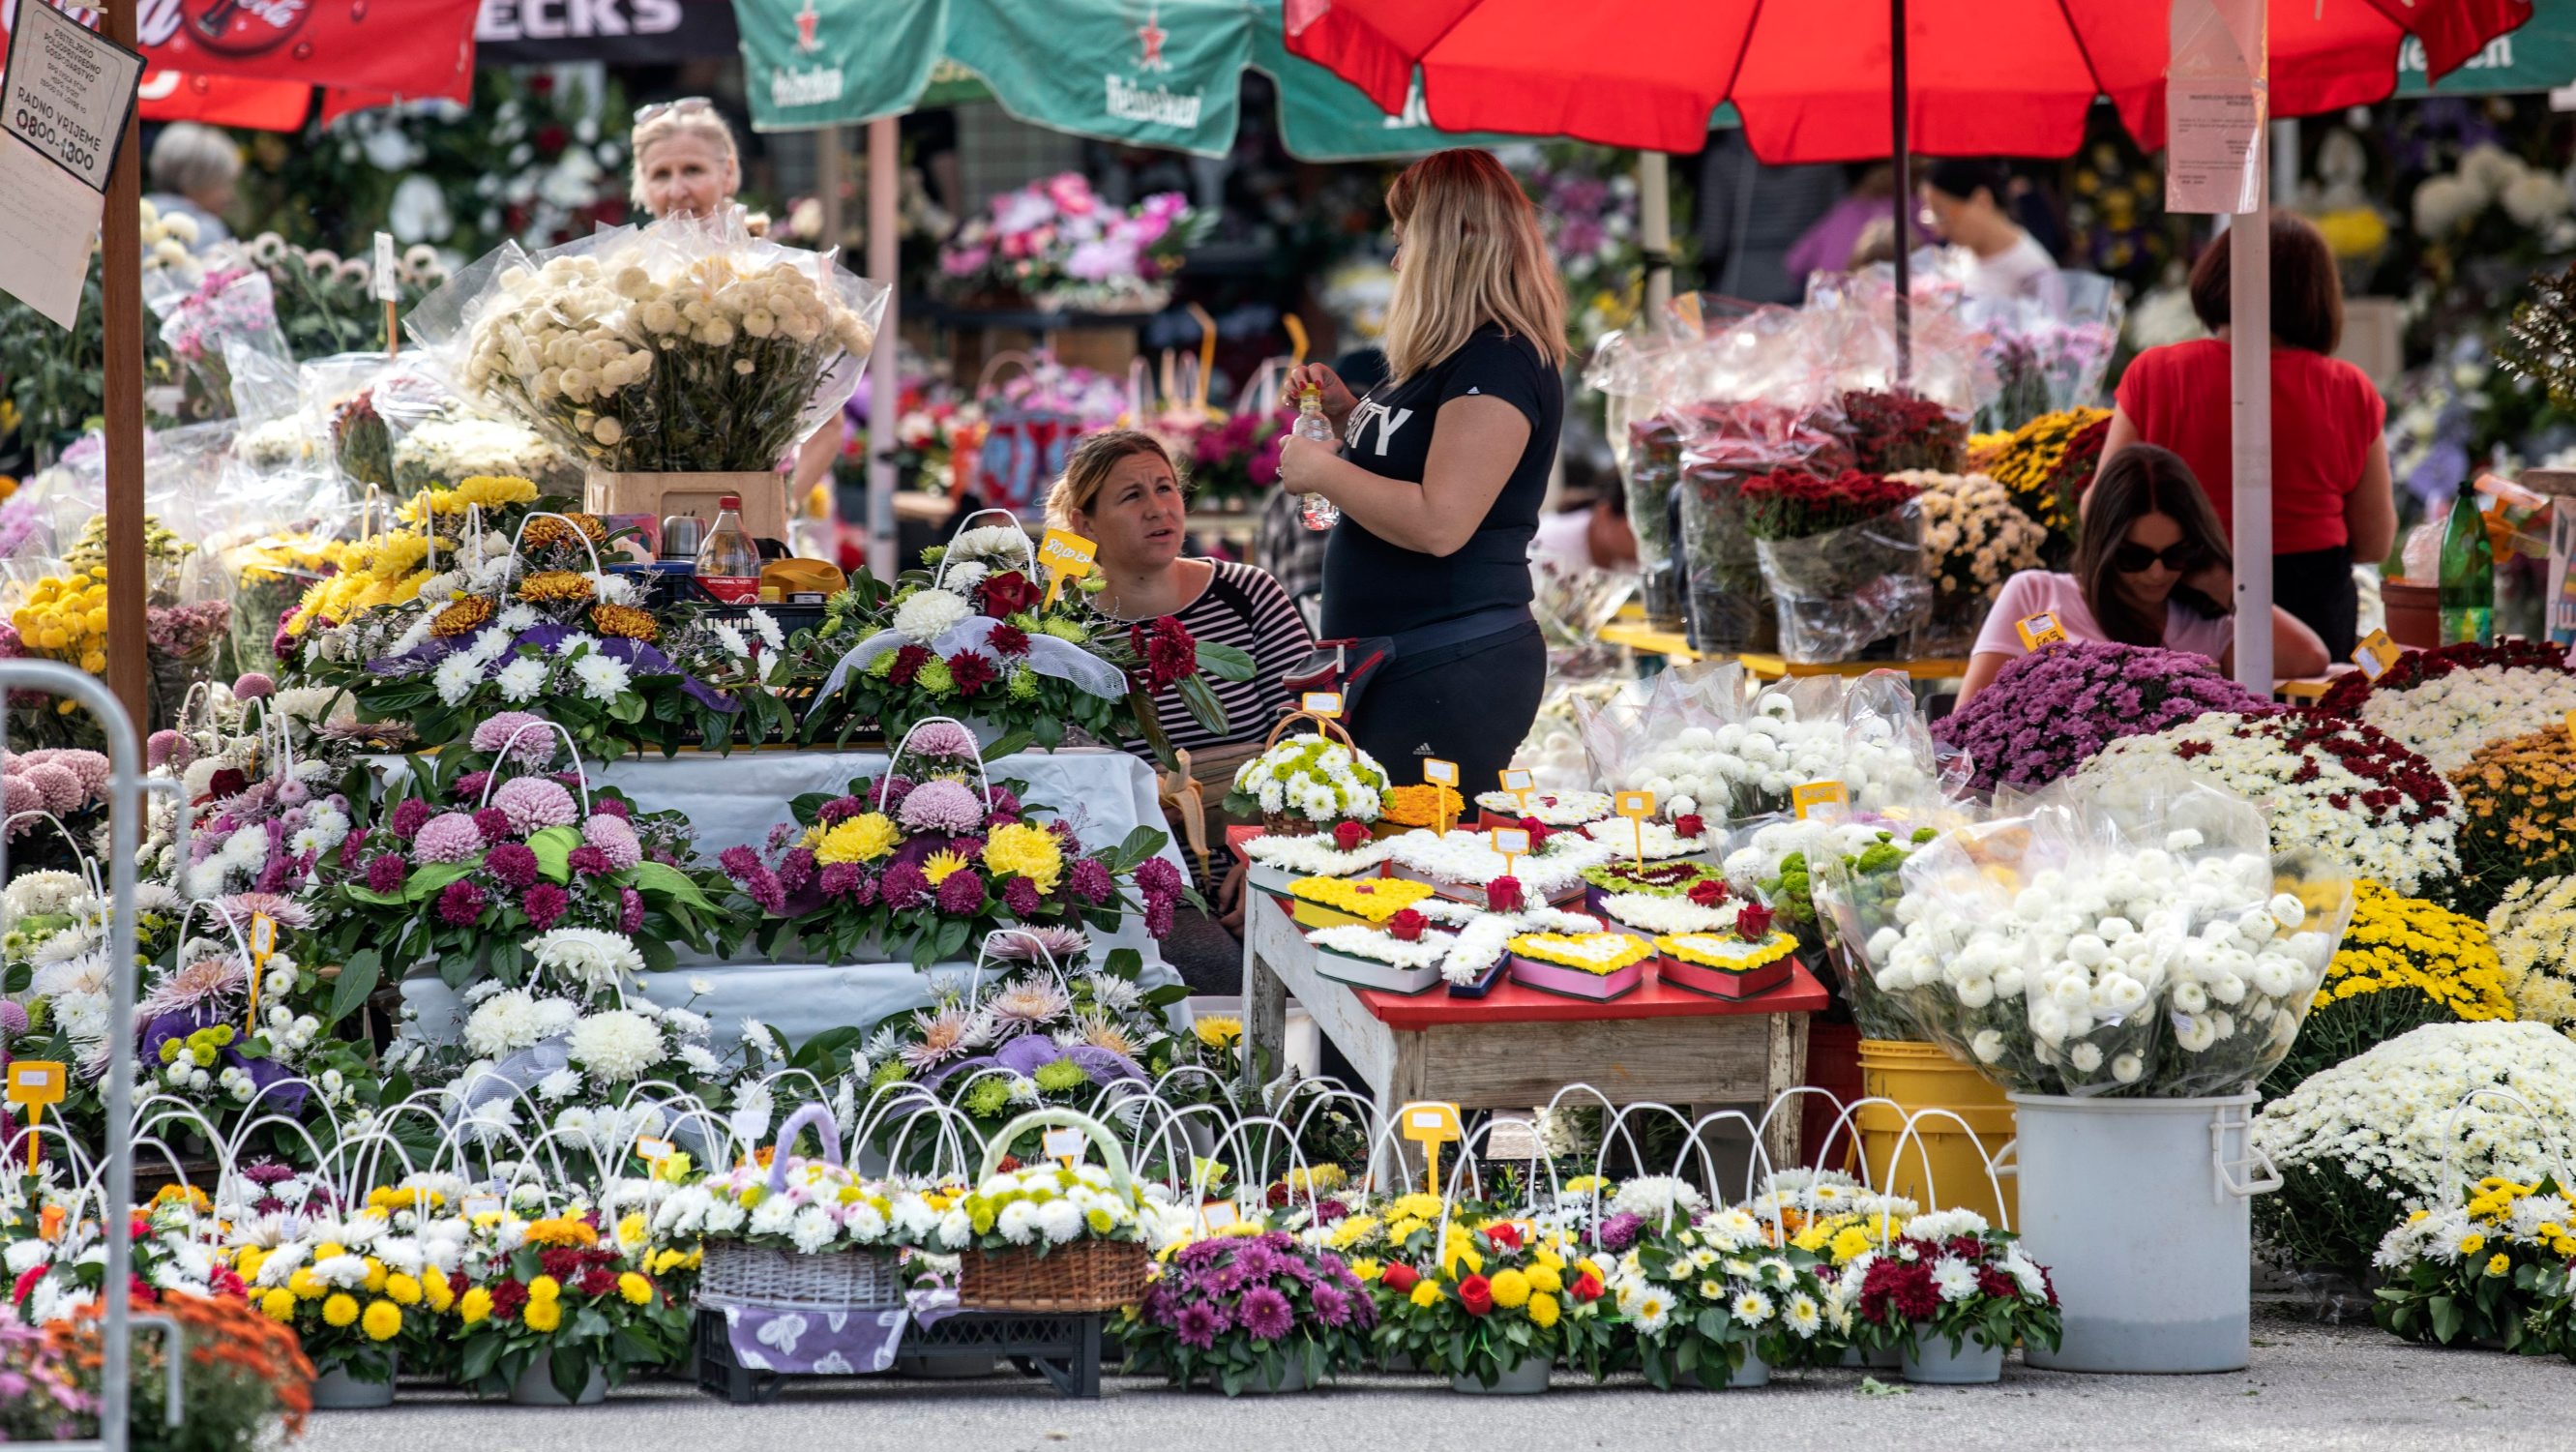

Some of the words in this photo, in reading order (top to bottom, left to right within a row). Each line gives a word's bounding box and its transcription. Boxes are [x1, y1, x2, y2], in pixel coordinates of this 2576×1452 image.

[474, 0, 683, 42] ECKS
[44, 33, 102, 74] POLJOPRIVREDNO
[45, 45, 95, 83] GOSPODARSTVO
[54, 29, 94, 58] OBITELJSKO
[16, 108, 94, 170] 0800-1300
[17, 86, 54, 119] RADNO
[56, 111, 102, 152] VRIJEME
